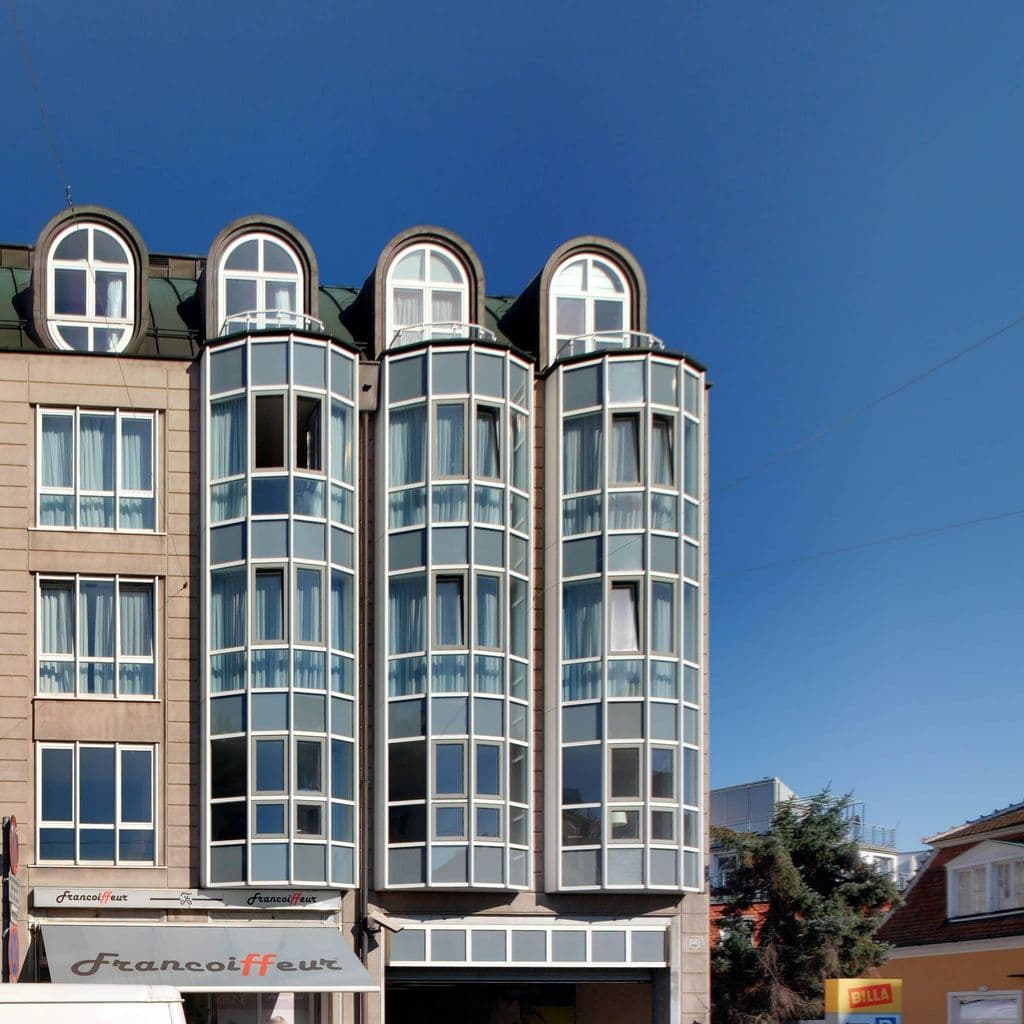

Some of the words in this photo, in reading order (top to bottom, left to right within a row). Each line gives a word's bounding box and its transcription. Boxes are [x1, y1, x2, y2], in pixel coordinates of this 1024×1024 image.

[55, 890, 128, 904] Francoiffeur
[247, 891, 317, 906] Francoiffeur
[70, 952, 343, 977] Francoiffeur
[850, 988, 890, 1004] BILLA
